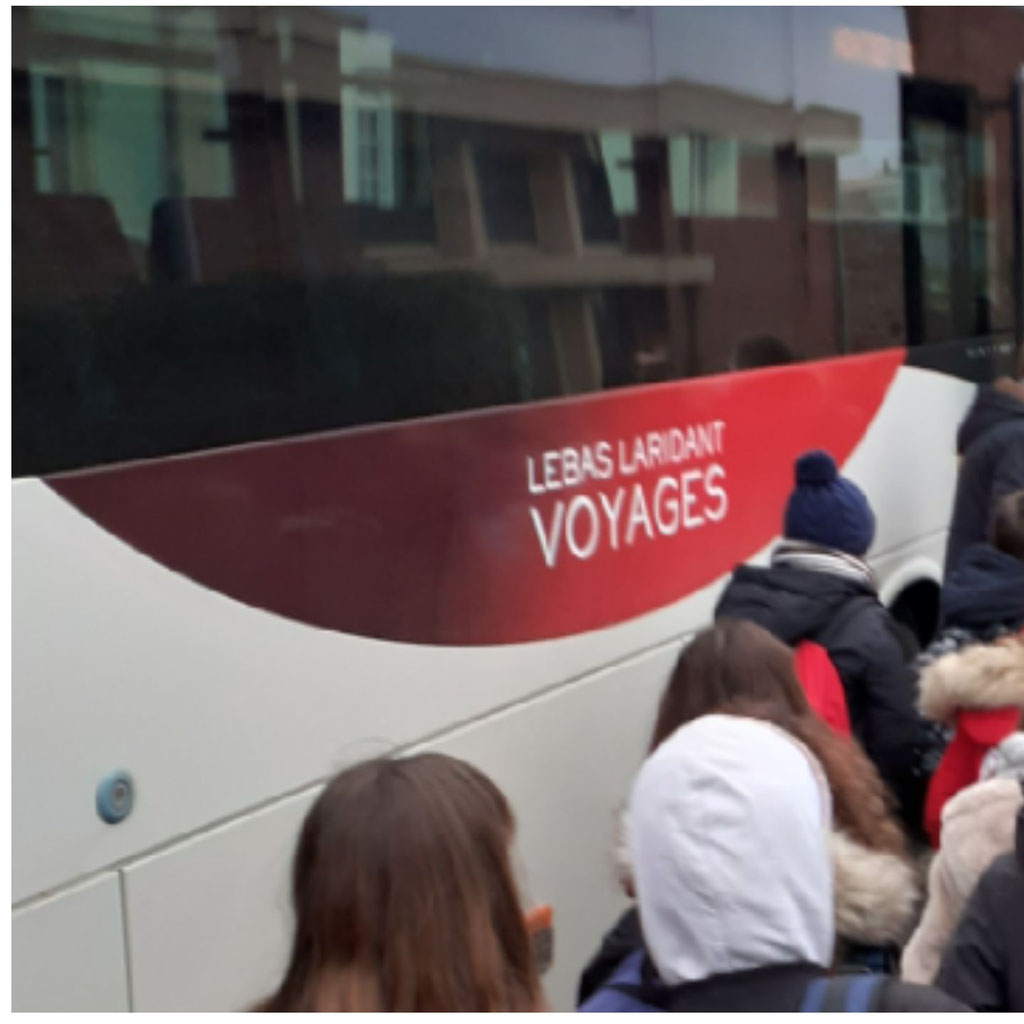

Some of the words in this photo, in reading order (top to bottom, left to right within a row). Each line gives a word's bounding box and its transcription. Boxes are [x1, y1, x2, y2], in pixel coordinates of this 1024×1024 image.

[526, 440, 614, 494] LEBAS
[618, 419, 726, 476] LARIDANT
[530, 463, 728, 568] VOYAGES
